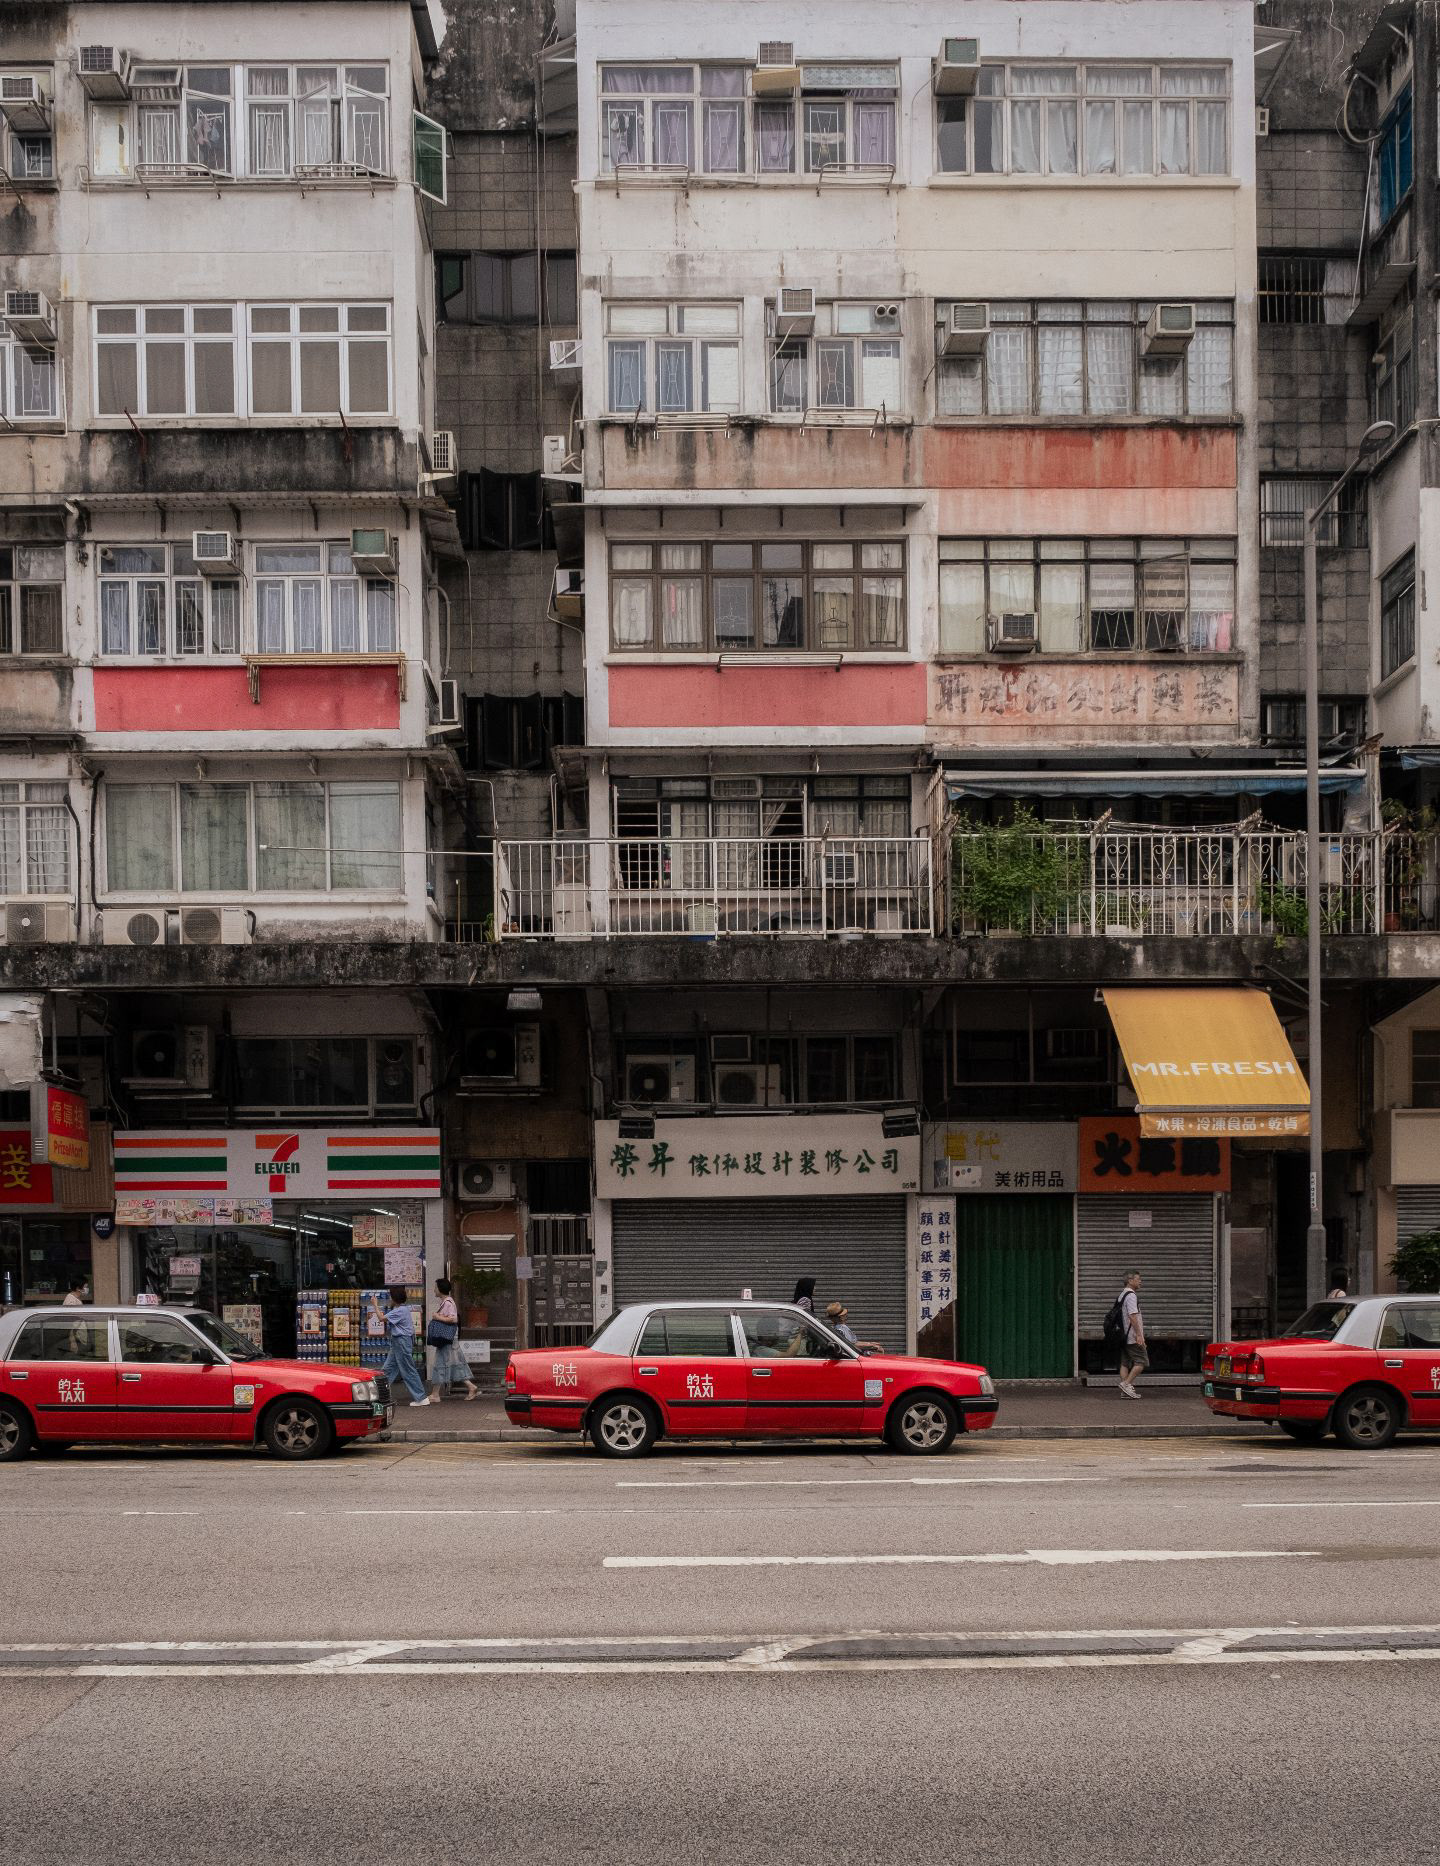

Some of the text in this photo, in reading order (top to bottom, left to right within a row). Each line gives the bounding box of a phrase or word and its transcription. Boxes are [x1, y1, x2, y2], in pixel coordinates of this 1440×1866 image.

[1131, 1061, 1297, 1077] MR.FRESH
[255, 1133, 299, 1193] 7
[994, 1170, 1064, 1188] 美術用品
[552, 1362, 577, 1375] 的士
[58, 1378, 85, 1391] 的士
[552, 1374, 577, 1387] TAXI
[687, 1373, 714, 1386] 的士
[58, 1390, 85, 1403] TAXI
[687, 1385, 714, 1398] TAXI
